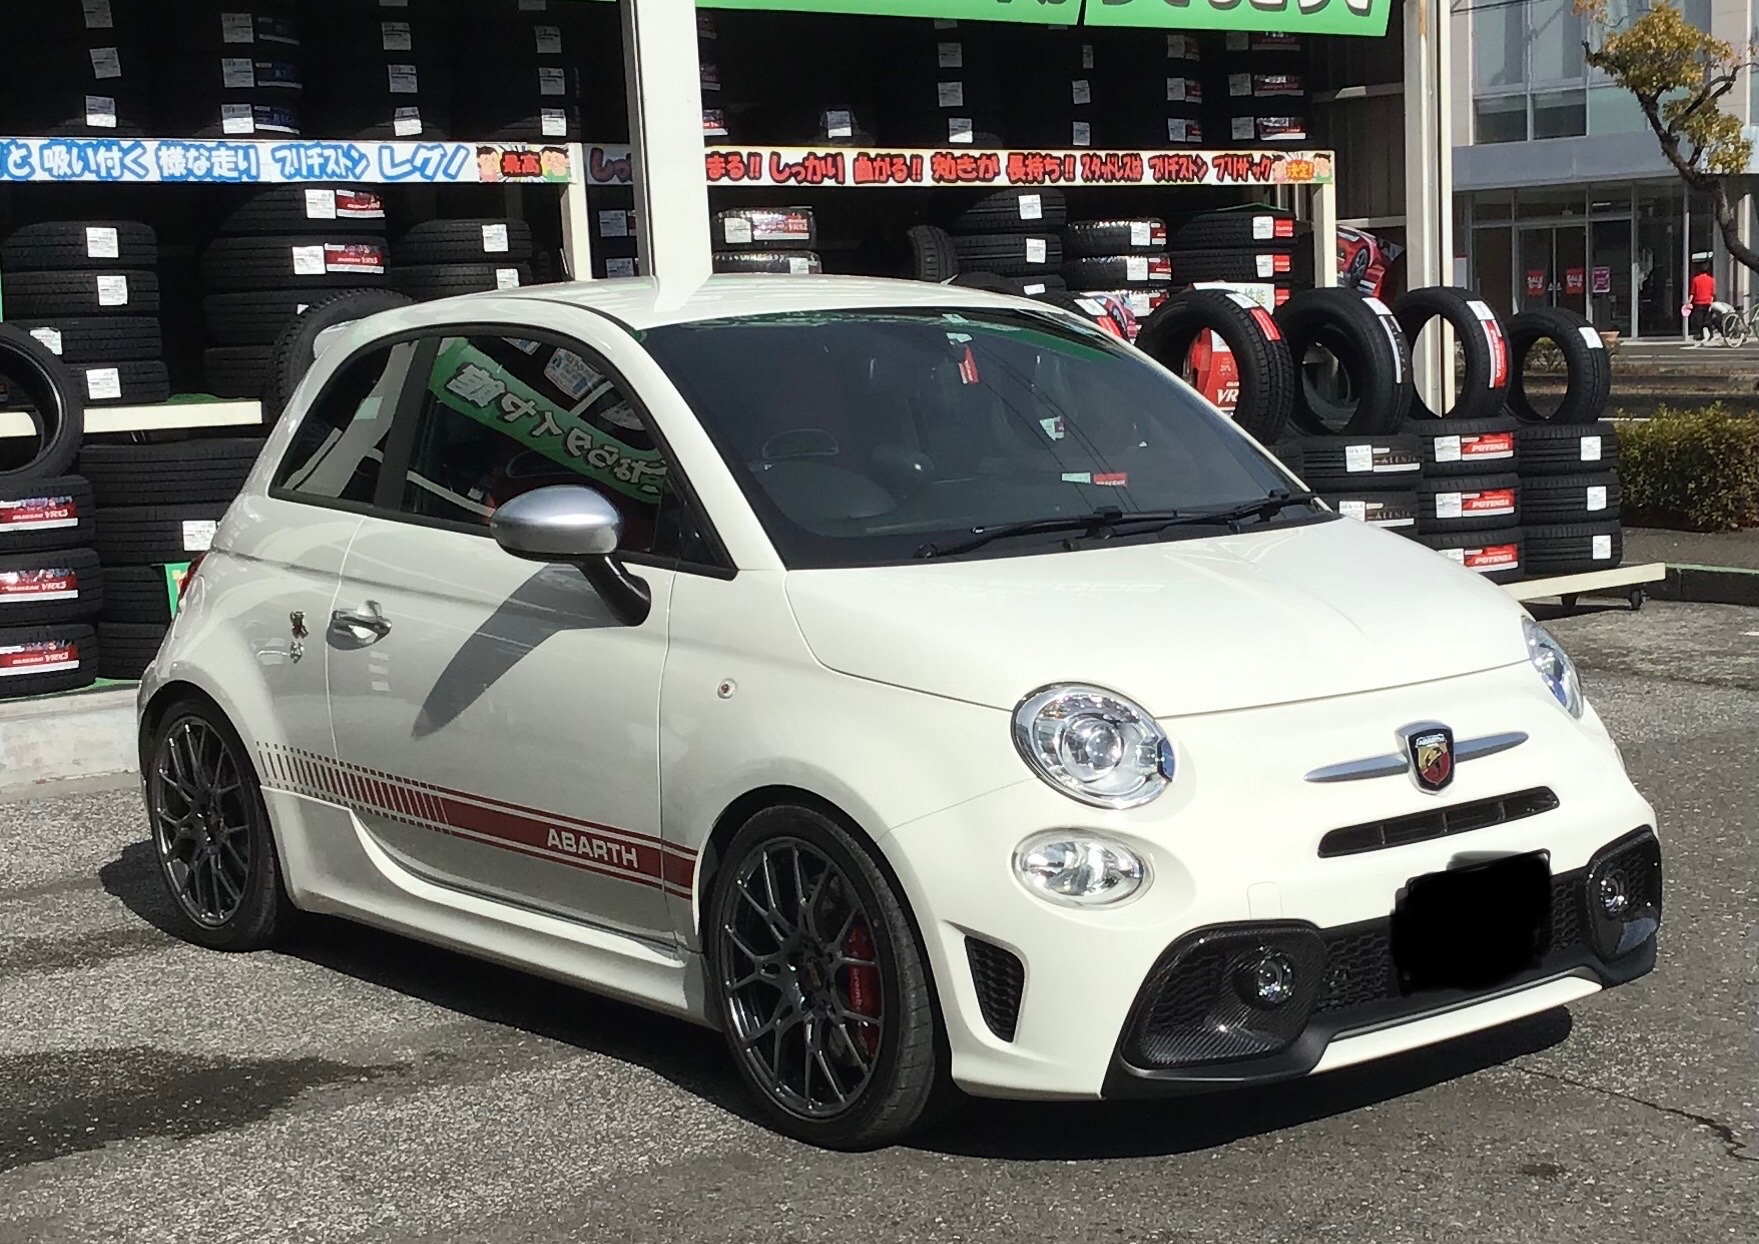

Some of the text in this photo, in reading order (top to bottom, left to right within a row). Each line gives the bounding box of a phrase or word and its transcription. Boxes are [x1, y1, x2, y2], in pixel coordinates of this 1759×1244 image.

[0, 140, 36, 180] と
[39, 139, 149, 180] 吸い付く
[156, 140, 261, 182] 様な走り
[589, 147, 632, 184] しっ
[705, 151, 762, 182] まる!!
[769, 151, 846, 185] しっかり
[1216, 388, 1240, 405] VR
[547, 828, 638, 868] ABARTH
